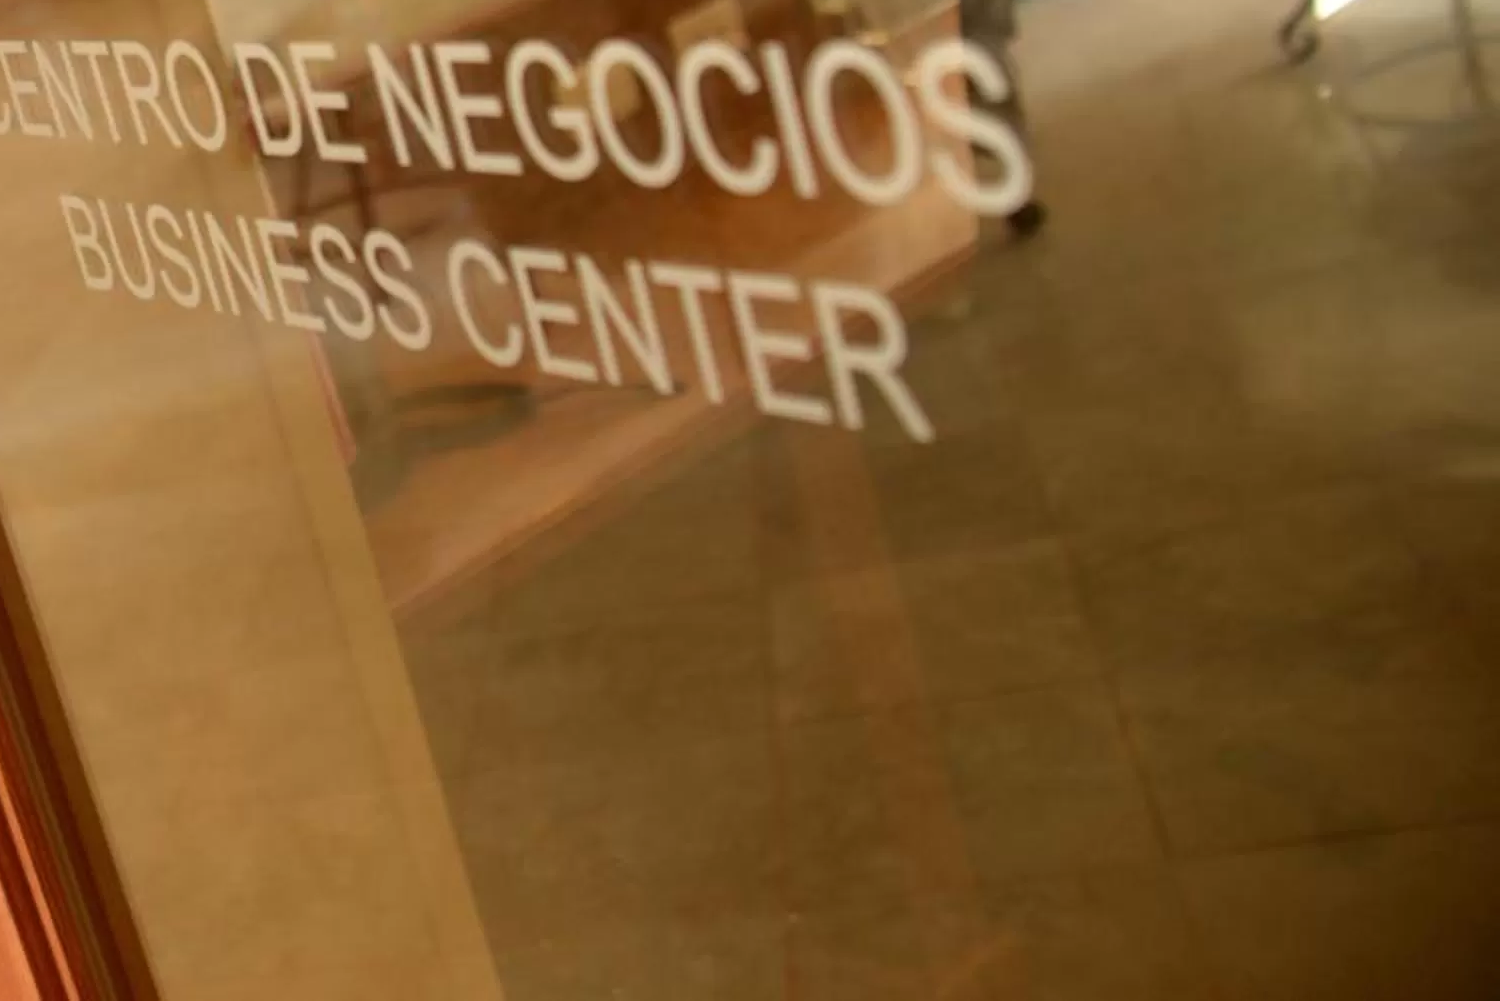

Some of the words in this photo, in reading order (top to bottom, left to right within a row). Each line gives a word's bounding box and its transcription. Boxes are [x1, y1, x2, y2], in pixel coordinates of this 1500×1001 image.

[233, 41, 368, 163] DE
[367, 39, 1033, 215] NEGOCIOS
[59, 193, 432, 351] BUSINESS
[448, 238, 935, 444] CENTER
